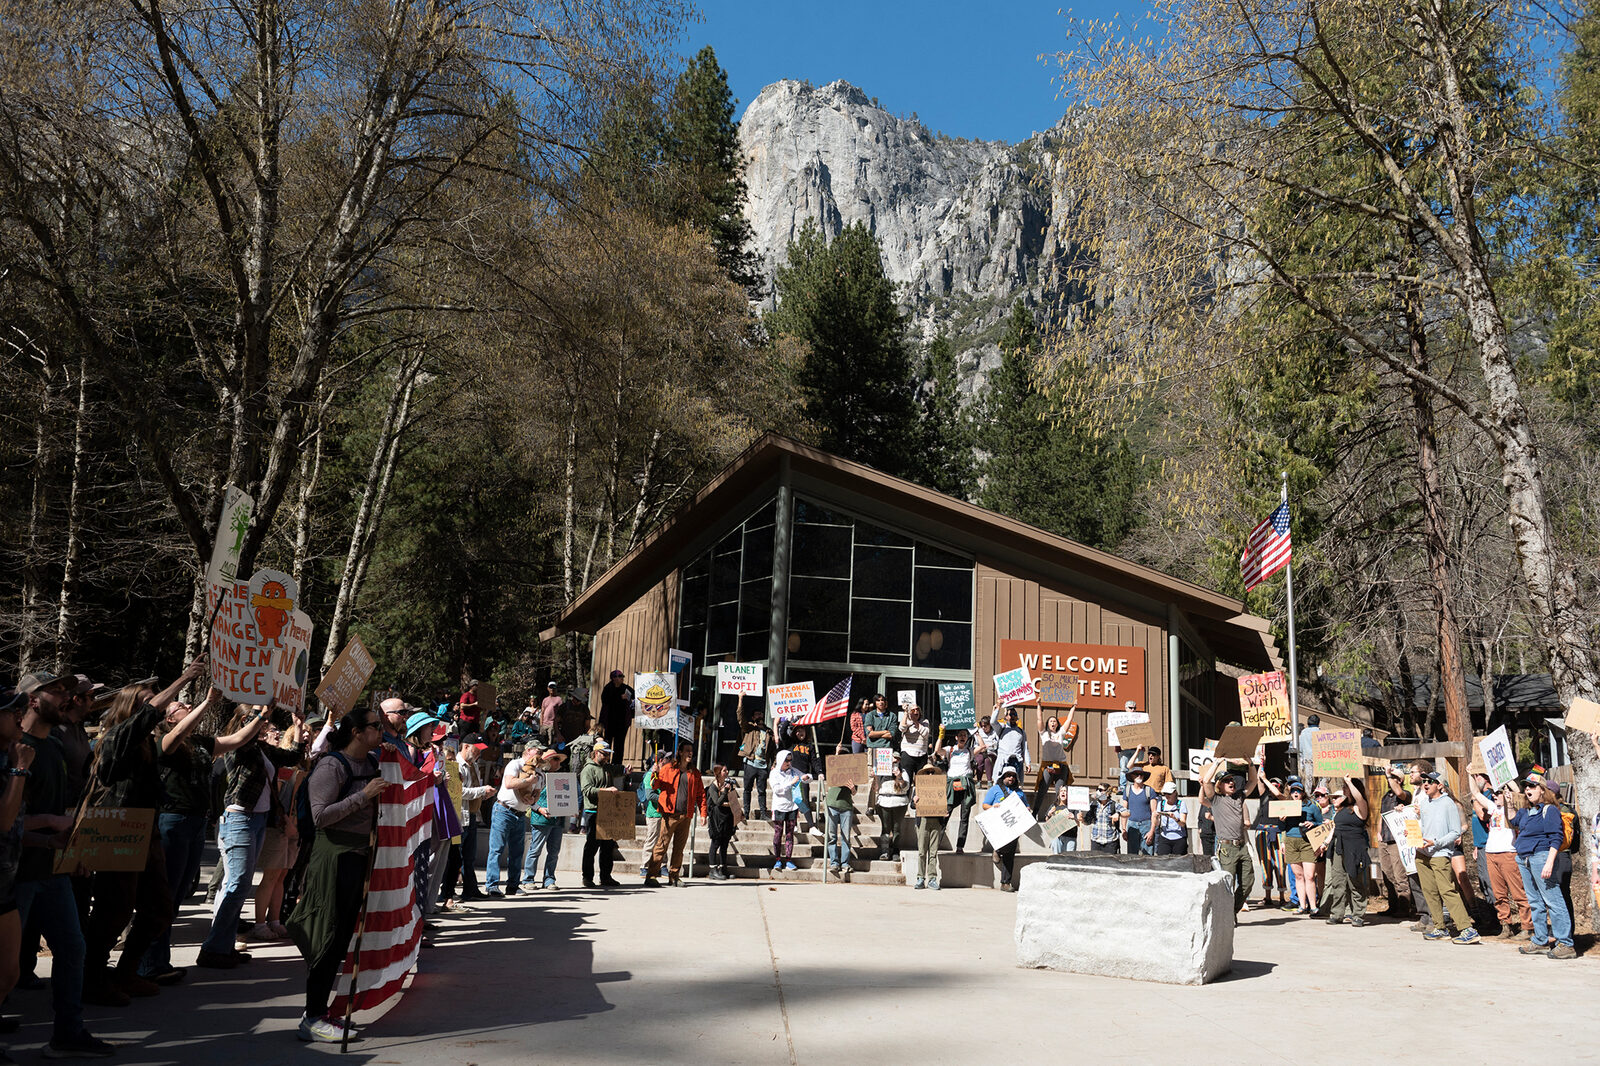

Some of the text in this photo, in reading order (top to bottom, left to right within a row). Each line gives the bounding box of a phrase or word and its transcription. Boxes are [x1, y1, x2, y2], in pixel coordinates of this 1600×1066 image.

[212, 631, 271, 667] MAN IN
[341, 660, 355, 679] JOB
[724, 664, 756, 675] PLANET
[1019, 653, 1129, 675] WELCOME
[212, 658, 266, 695] OFFICE
[997, 669, 1023, 685] FUCK
[1061, 675, 1078, 684] MUCH
[721, 680, 757, 691] PROFIT
[769, 684, 810, 694] NATIONAL
[1032, 677, 1117, 698] CTER
[1243, 672, 1281, 696] Stand
[944, 695, 970, 704] BEARS
[1248, 692, 1278, 708] With
[777, 704, 809, 714] GREAT
[1317, 732, 1354, 742] WATCH THEM
[1321, 750, 1351, 759] DESTROY
